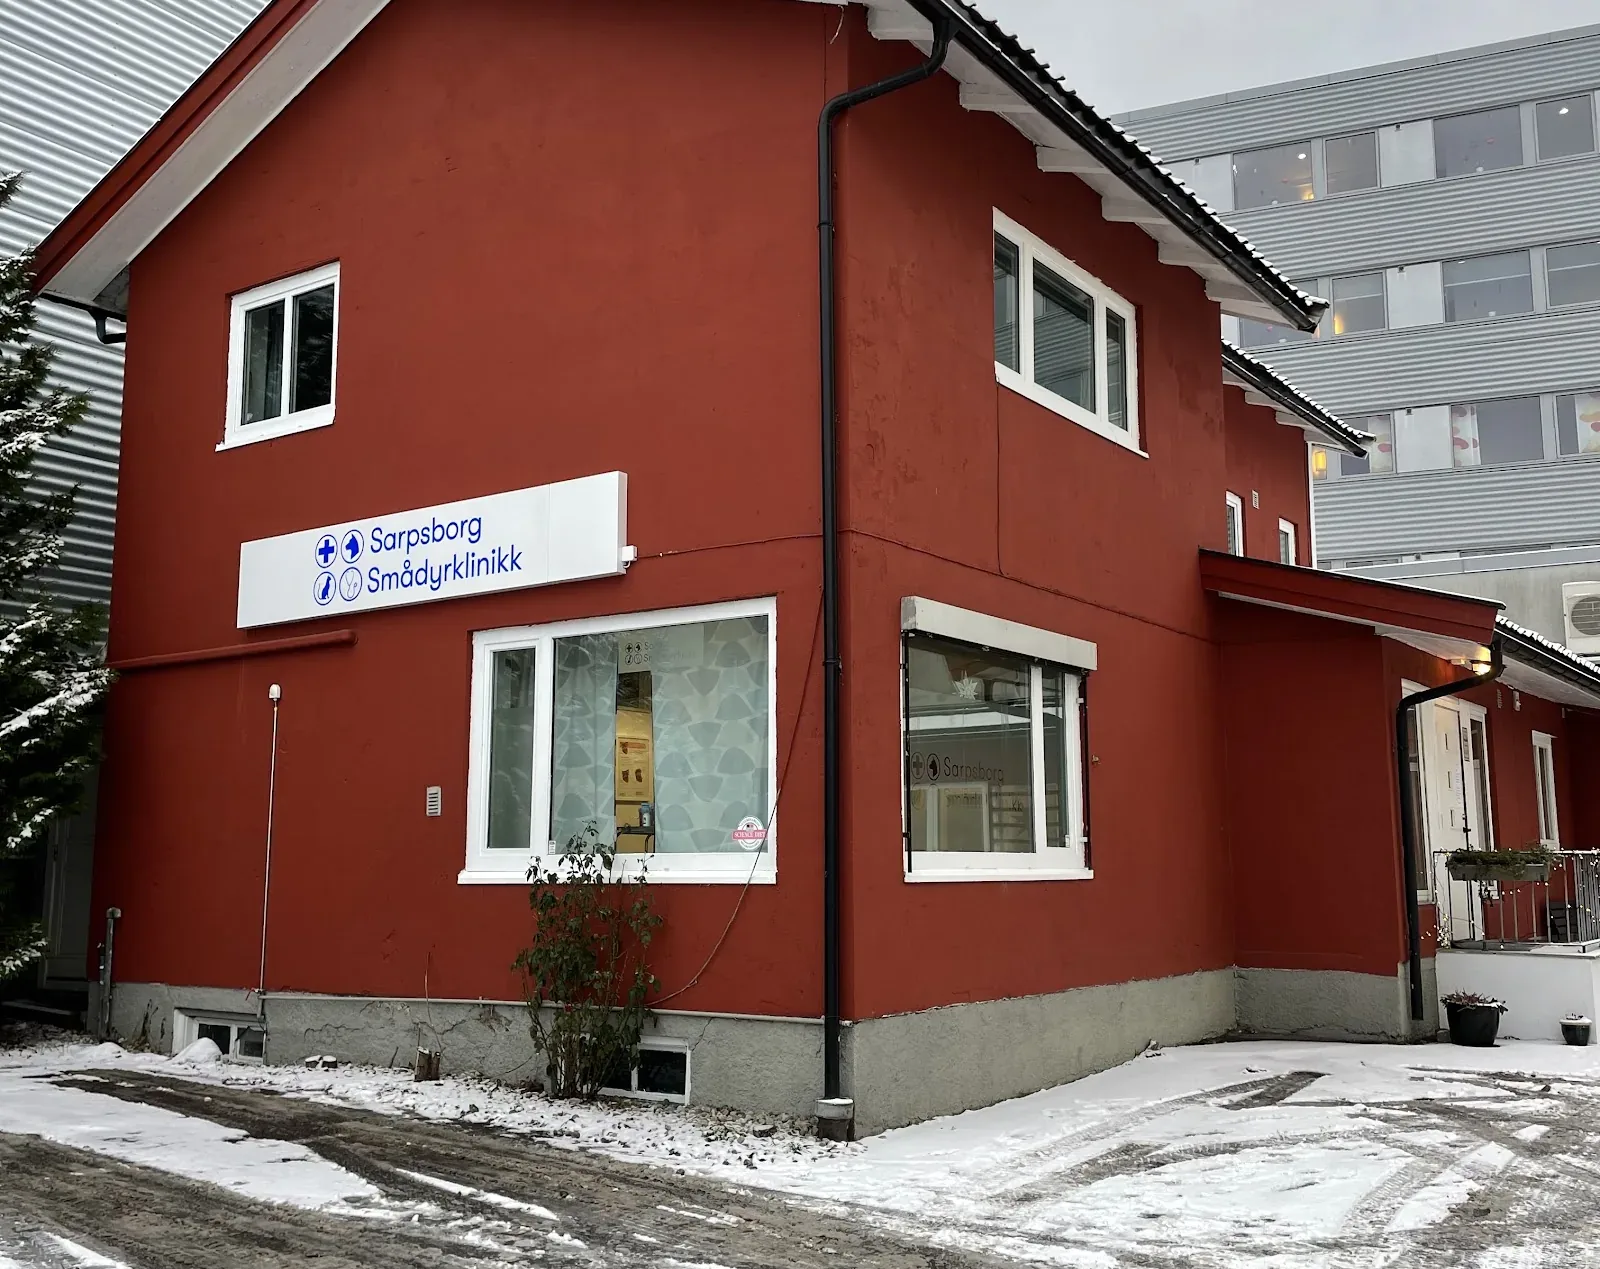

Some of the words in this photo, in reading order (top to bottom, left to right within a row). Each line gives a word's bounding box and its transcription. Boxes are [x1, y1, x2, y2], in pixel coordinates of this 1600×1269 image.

[370, 517, 482, 554] Sarpsborg
[367, 545, 523, 593] Smådyrklinikk
[943, 756, 1004, 787] Sarpsborg
